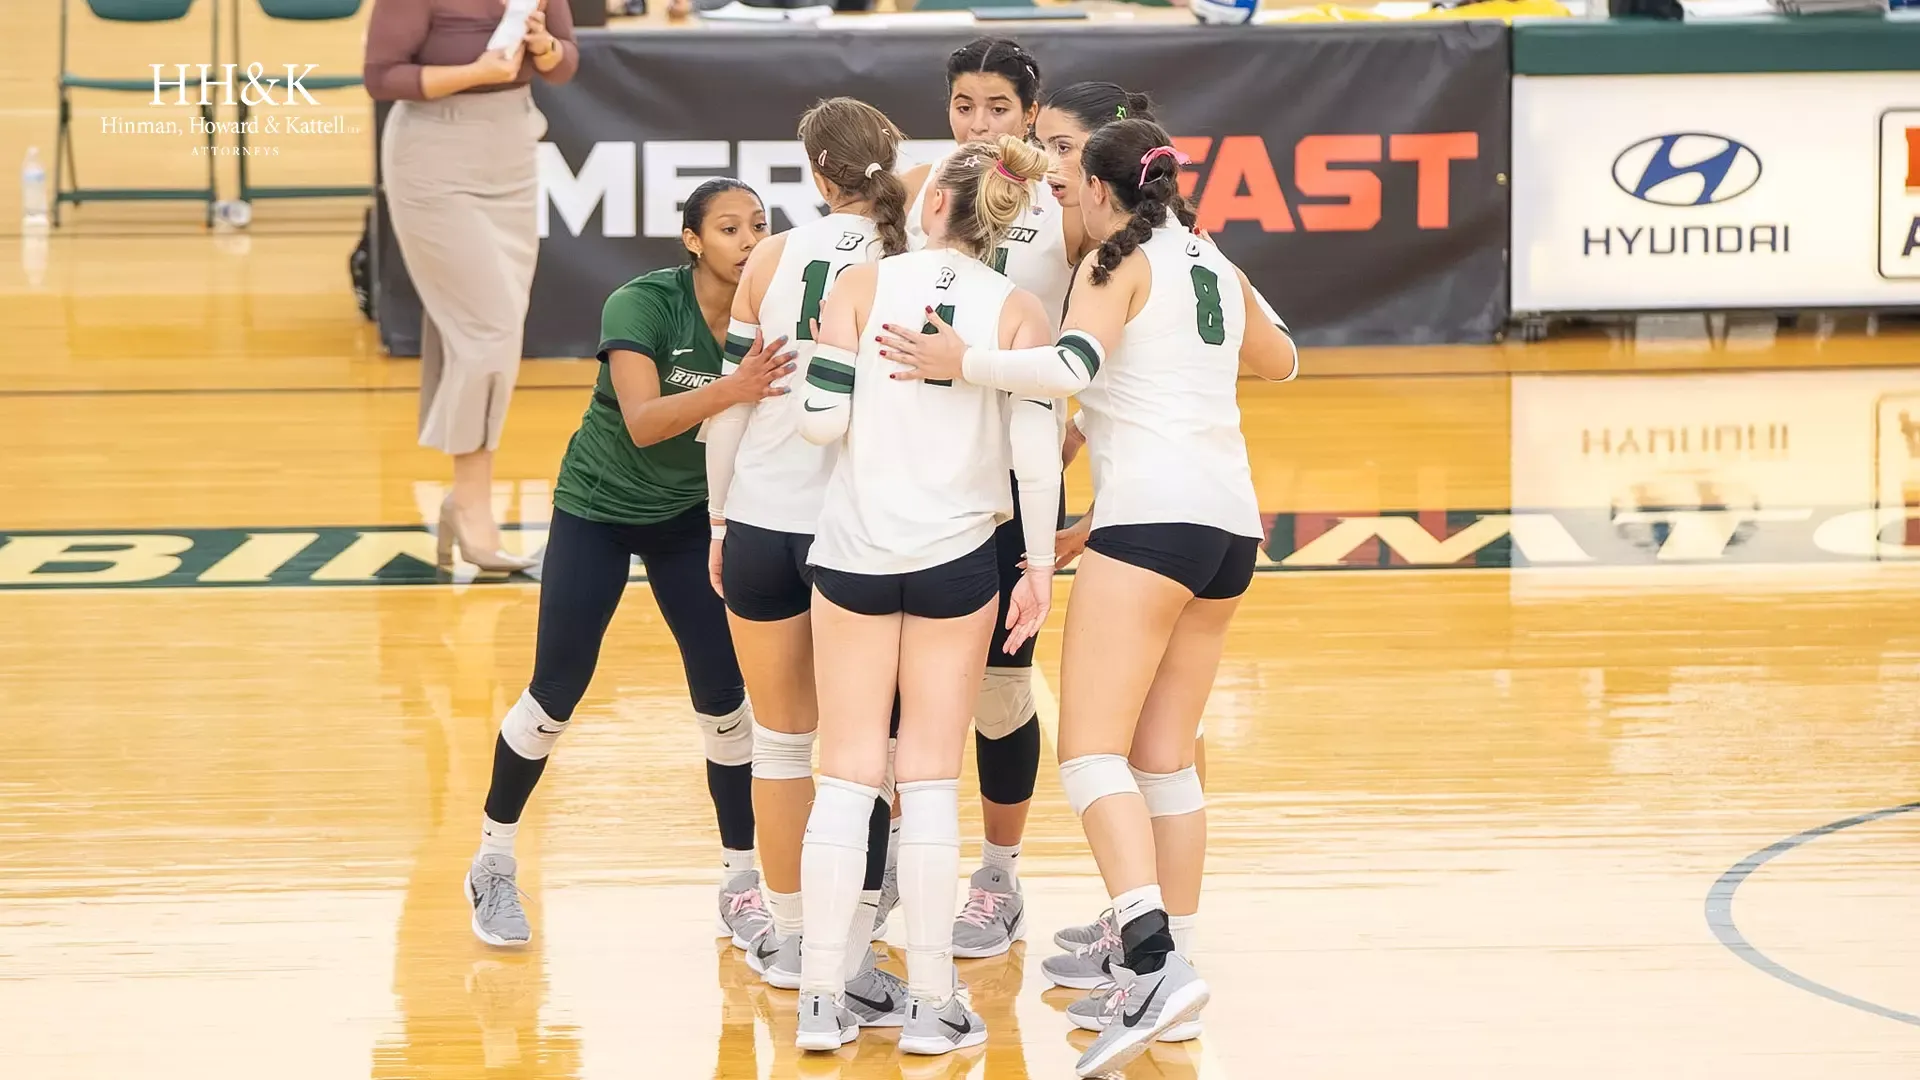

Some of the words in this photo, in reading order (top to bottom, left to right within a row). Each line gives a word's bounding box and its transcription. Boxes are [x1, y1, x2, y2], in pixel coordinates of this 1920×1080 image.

[1584, 225, 1790, 255] HYUNDAI
[796, 260, 854, 341] 1
[1190, 264, 1225, 346] 8
